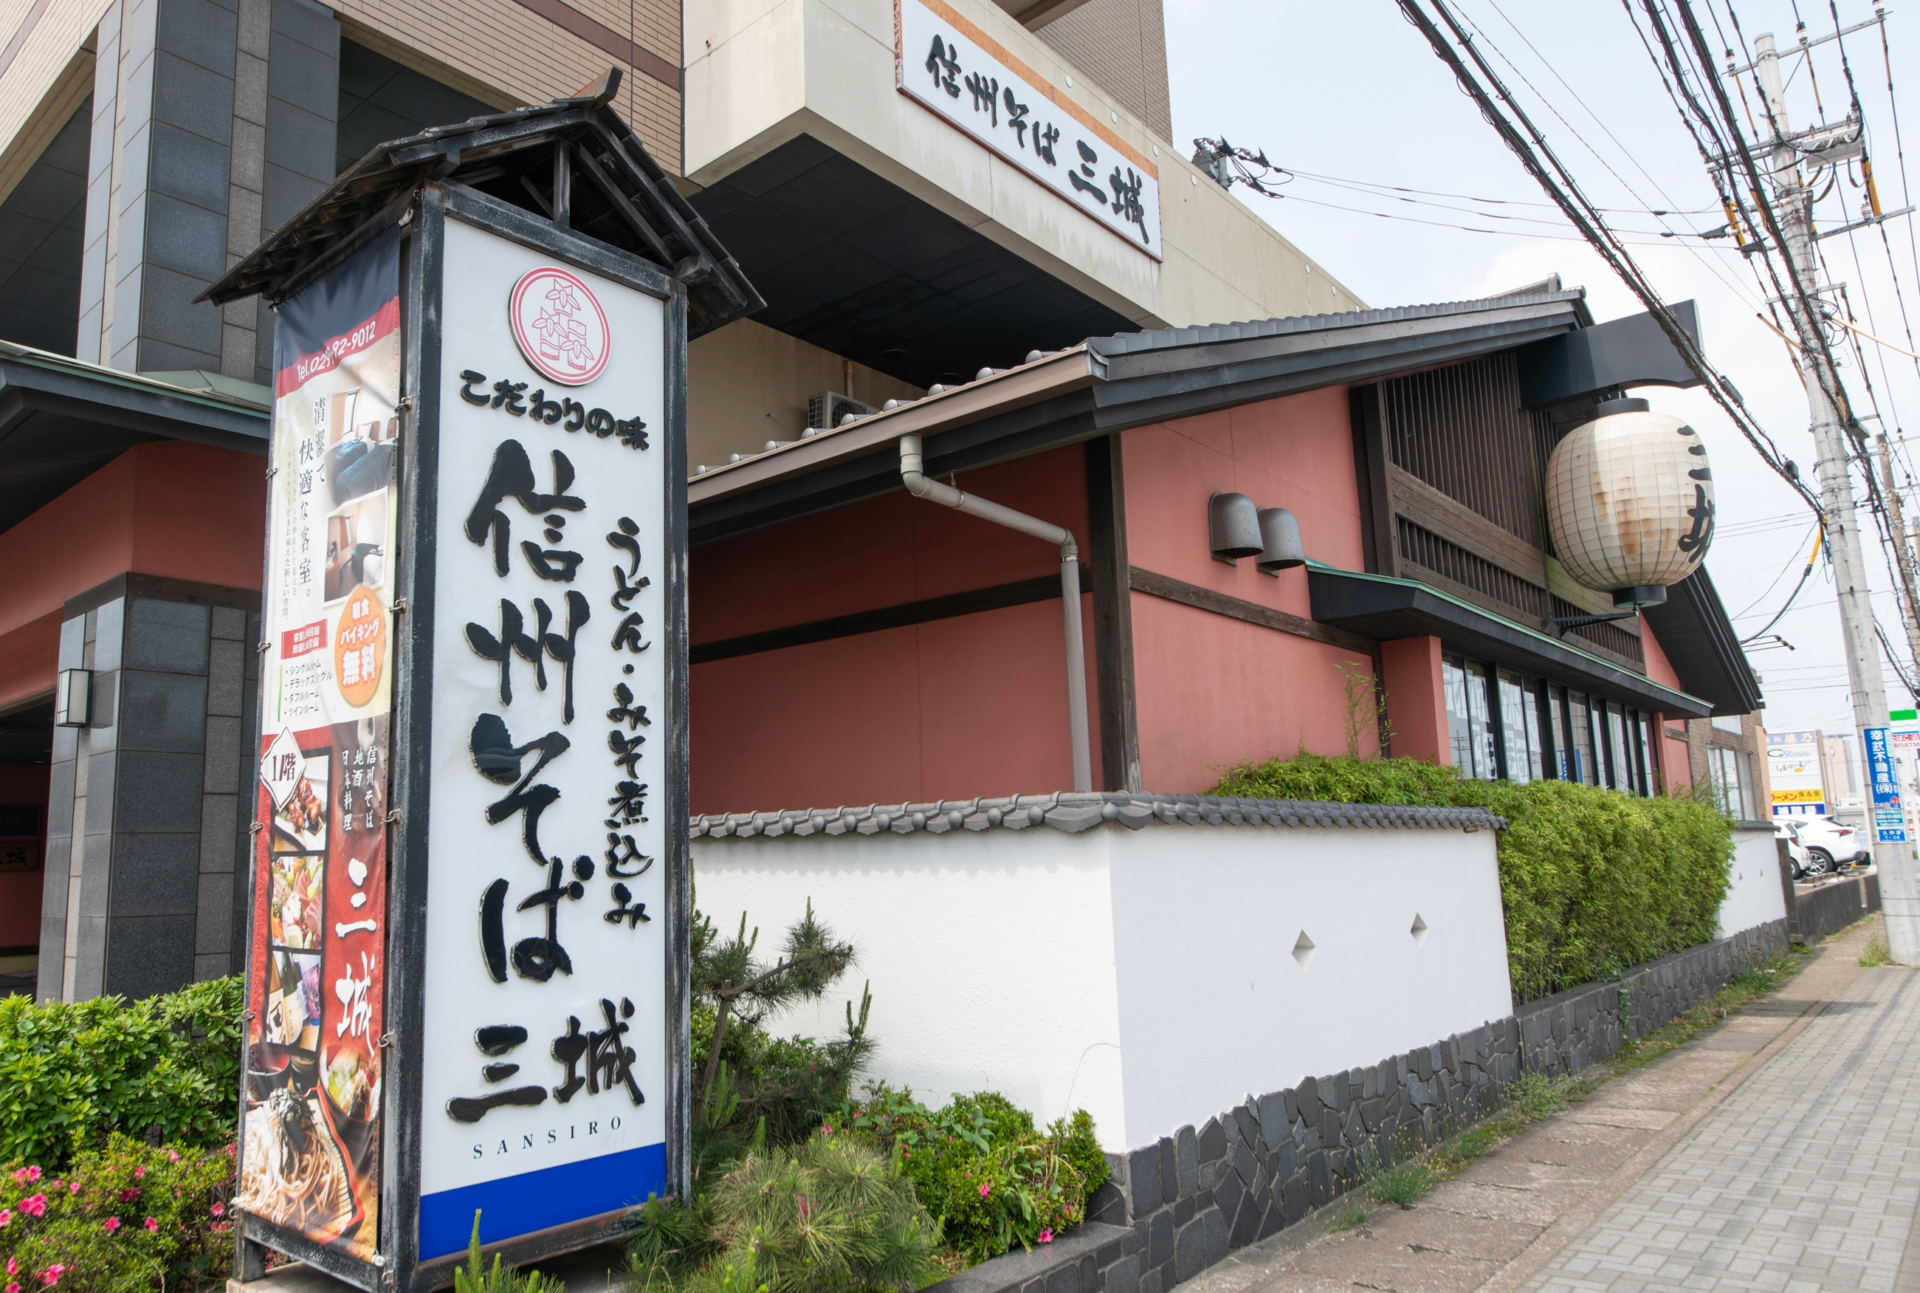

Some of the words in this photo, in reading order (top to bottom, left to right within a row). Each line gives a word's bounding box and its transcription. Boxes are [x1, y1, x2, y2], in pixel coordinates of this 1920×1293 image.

[925, 34, 1060, 166] 信州そば
[1068, 139, 1149, 244] 三城
[313, 397, 326, 483] 清潔で
[460, 369, 649, 451] こだわりの味
[340, 617, 380, 646] バイキング
[342, 643, 376, 686] 無料
[463, 438, 595, 984] 信州そば
[604, 516, 655, 930] うどん・みそ煮込み
[271, 753, 297, 782] 1階
[341, 750, 353, 831] 日本料理
[352, 747, 364, 787] 地酒
[364, 745, 378, 829] 信州そば
[335, 857, 377, 1058] 三城
[445, 996, 645, 1123] 三城
[473, 1116, 622, 1159] SANSIRO
